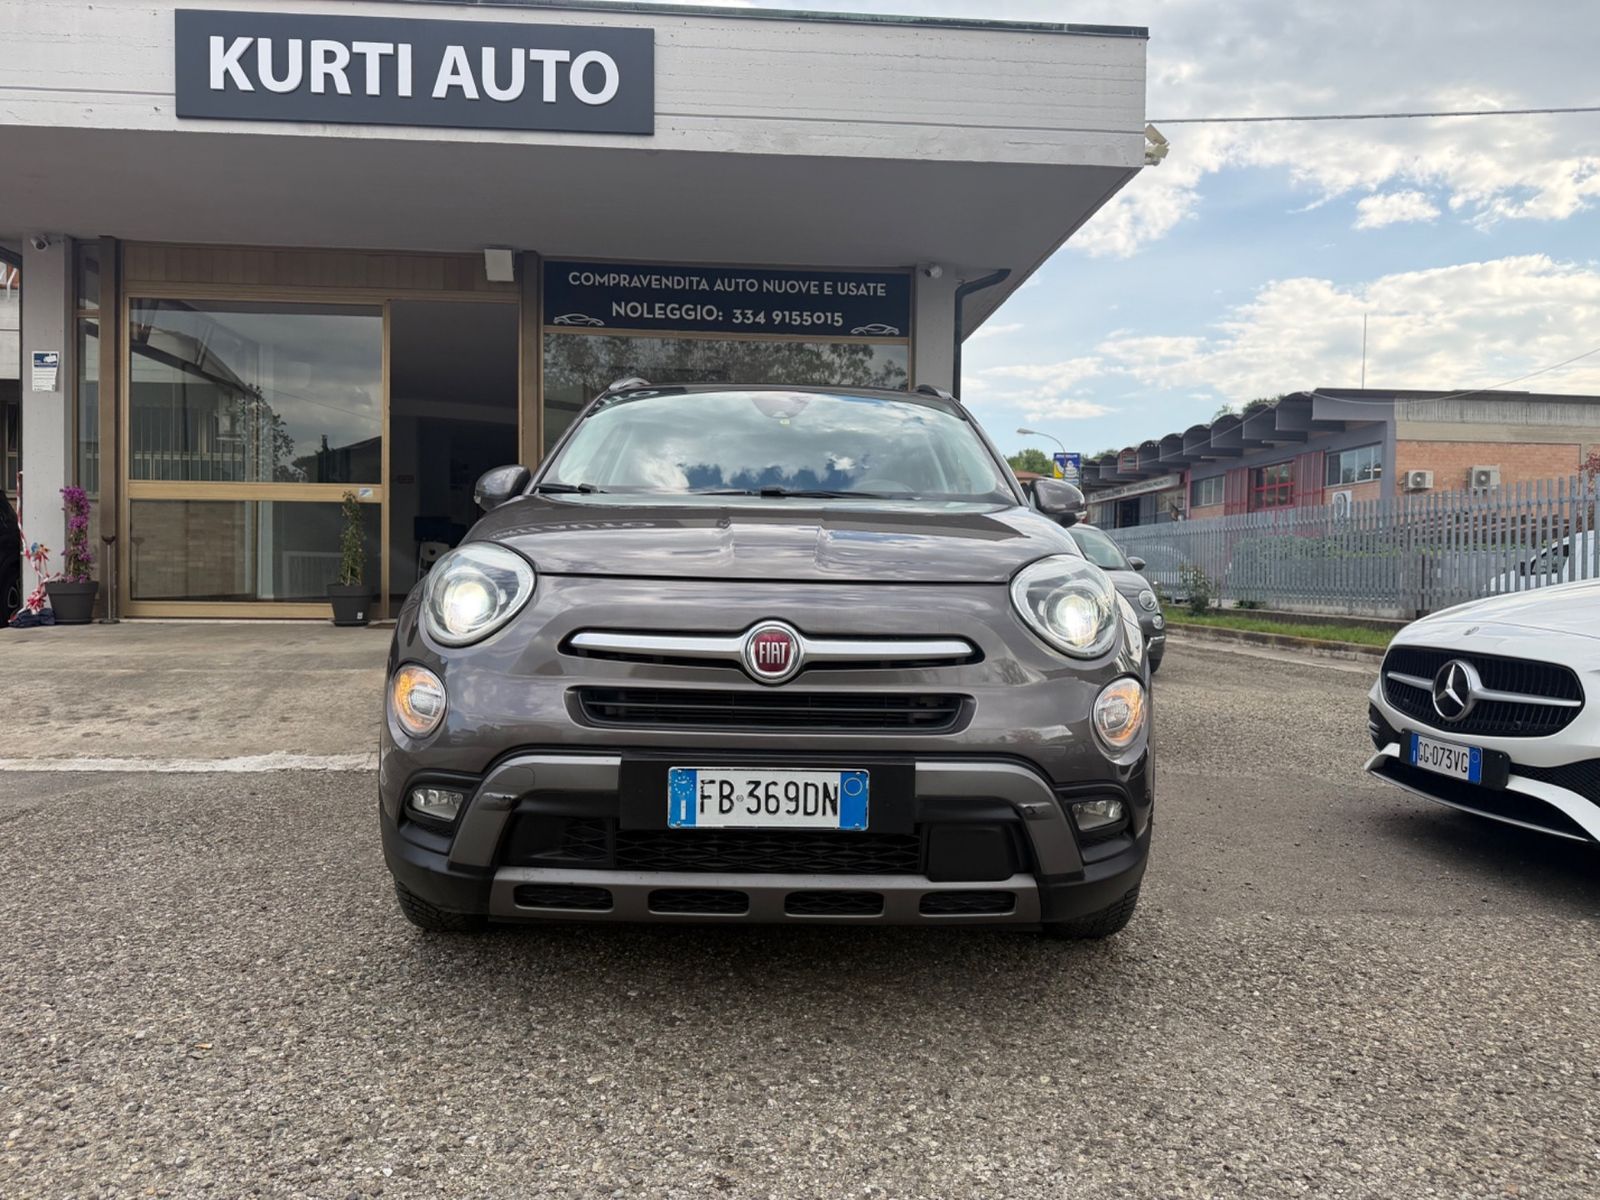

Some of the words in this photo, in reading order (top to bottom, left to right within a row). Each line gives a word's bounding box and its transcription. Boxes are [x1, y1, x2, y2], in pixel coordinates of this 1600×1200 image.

[208, 35, 412, 97] KURTI
[432, 45, 619, 105] AUTO
[568, 271, 710, 291] COMPRAVENDITA
[713, 278, 759, 292] AUTO
[762, 279, 819, 295] NUOVE
[823, 281, 833, 295] E
[837, 282, 887, 297] USATE
[611, 301, 723, 321] NOLEGGIO:
[731, 308, 766, 325] 334
[772, 310, 844, 327] 9155015
[759, 641, 788, 664] FIAT
